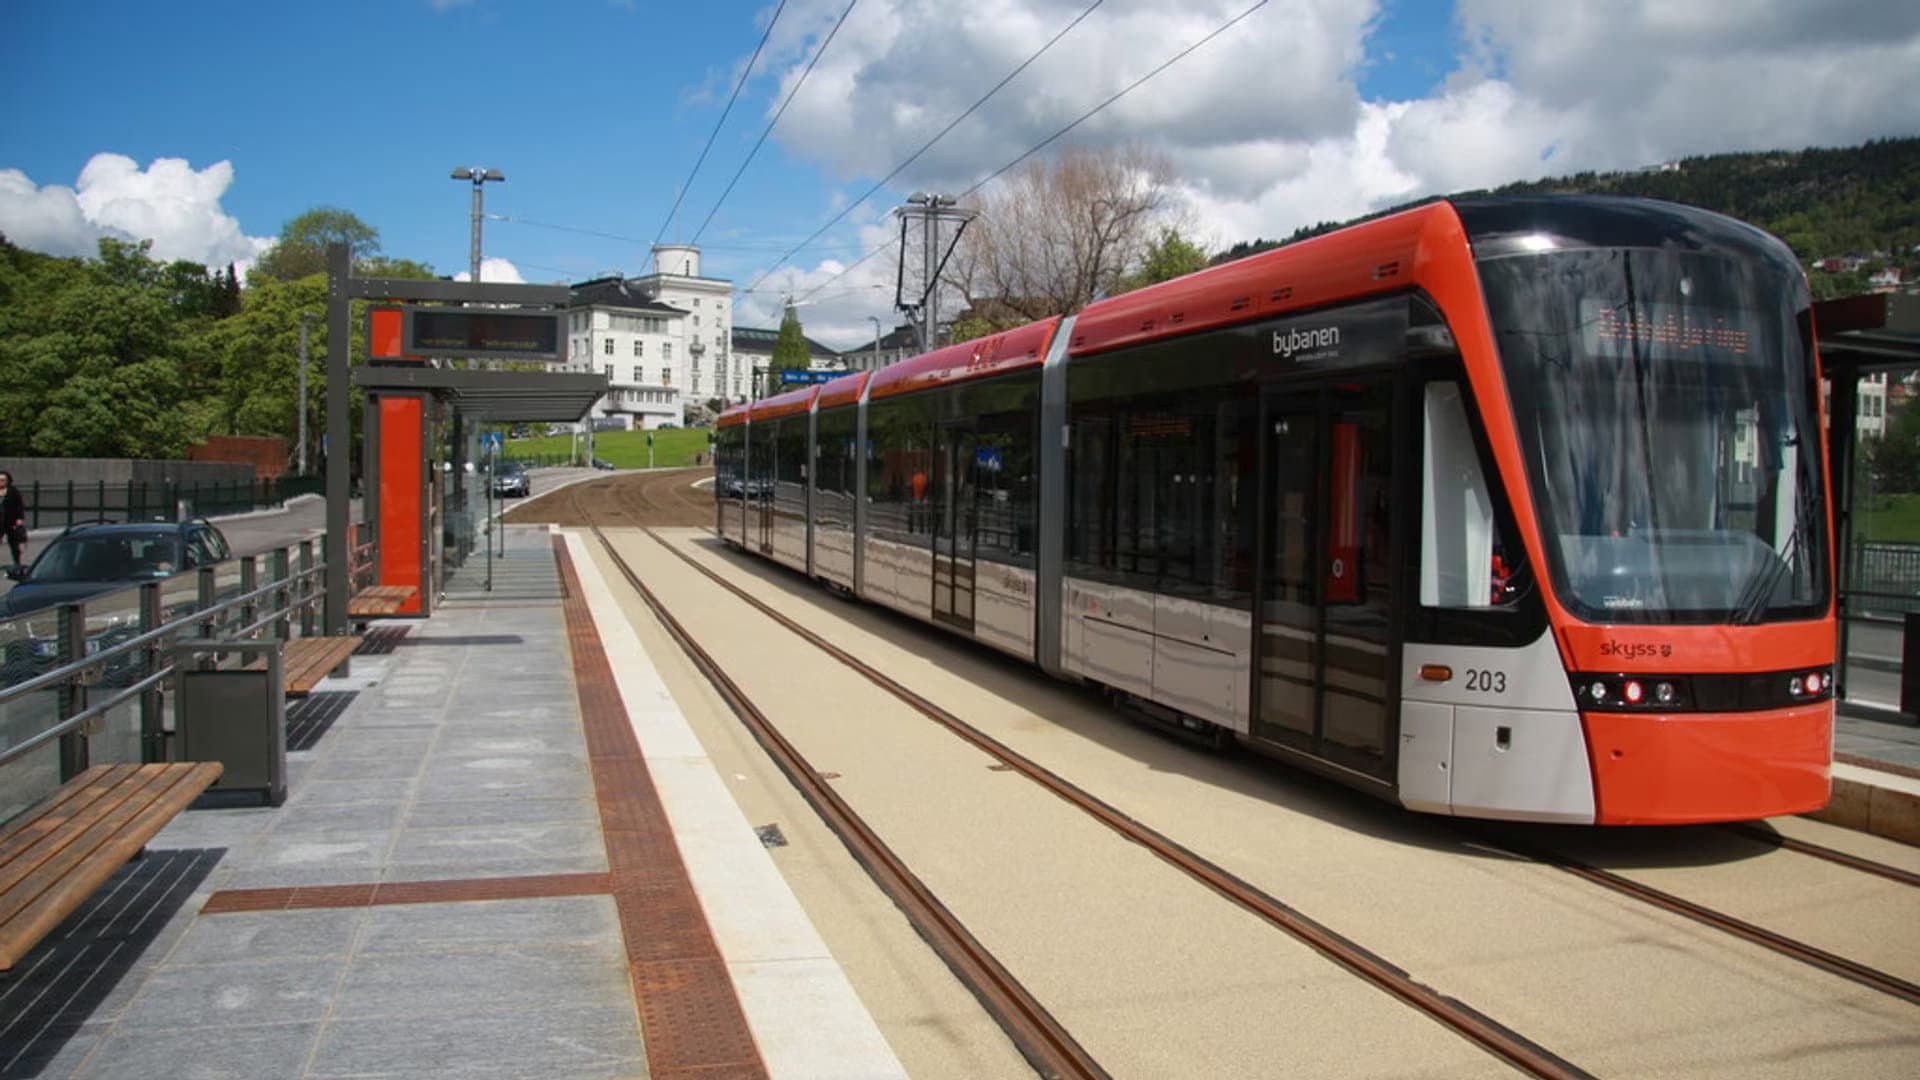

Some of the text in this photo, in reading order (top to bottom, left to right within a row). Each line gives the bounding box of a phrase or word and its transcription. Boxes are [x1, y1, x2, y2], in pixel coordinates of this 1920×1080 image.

[1273, 326, 1340, 358] bybanen
[1600, 639, 1657, 660] skyss
[1465, 669, 1507, 693] 203
